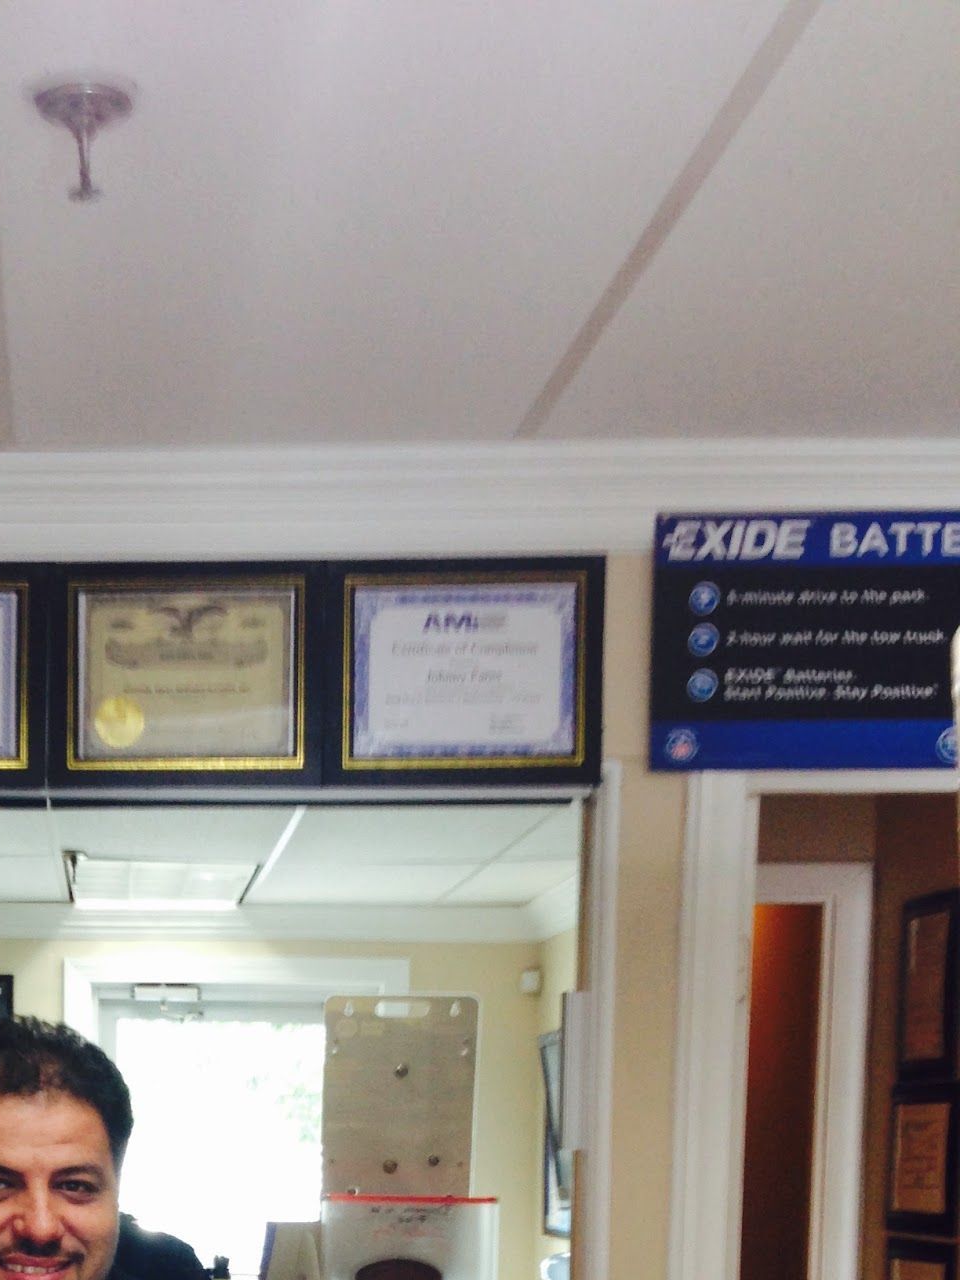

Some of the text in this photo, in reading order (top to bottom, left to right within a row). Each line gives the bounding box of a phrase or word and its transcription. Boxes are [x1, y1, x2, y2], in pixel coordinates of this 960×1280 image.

[663, 518, 960, 562] EXIDE BATTE
[797, 588, 838, 606] drive
[840, 589, 859, 605] to
[860, 588, 888, 605] the
[779, 629, 813, 646] wait
[815, 629, 839, 646] for
[841, 629, 868, 645] the
[870, 630, 902, 645] tow
